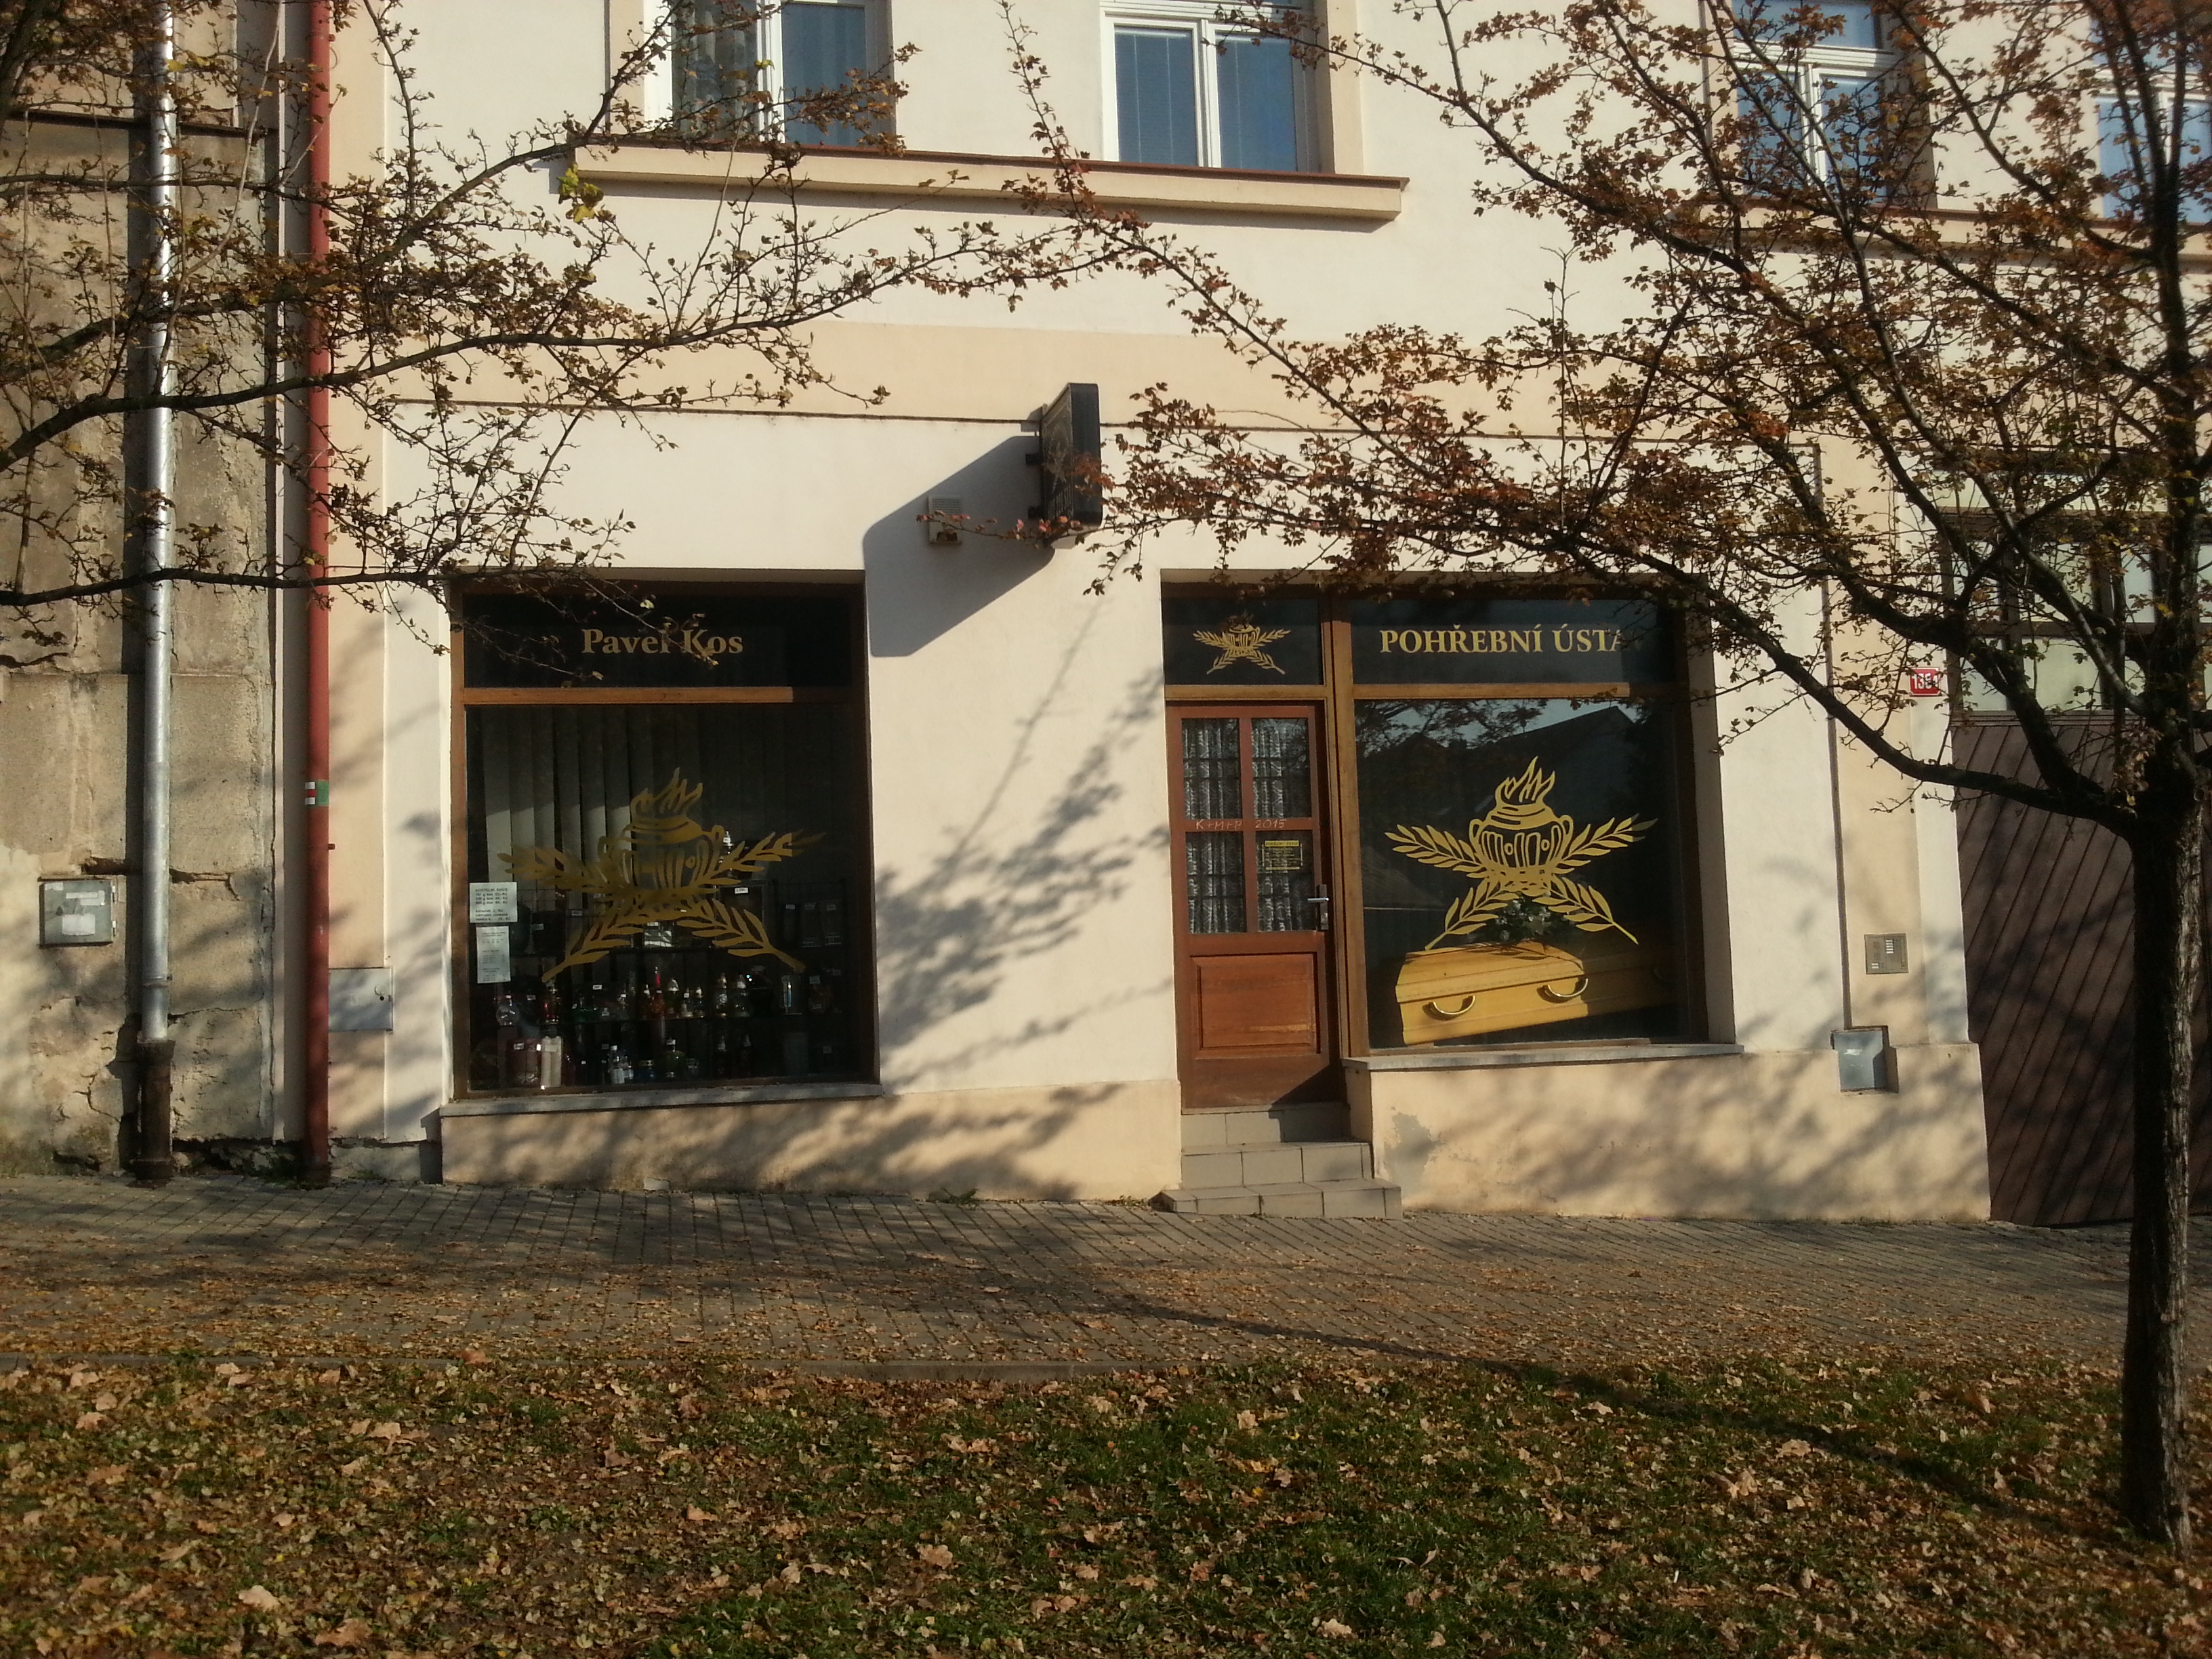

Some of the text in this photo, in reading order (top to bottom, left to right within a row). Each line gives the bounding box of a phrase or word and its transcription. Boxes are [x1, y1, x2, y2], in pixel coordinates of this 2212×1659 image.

[581, 628, 744, 654] Pavel Kos
[1380, 623, 1542, 653] POHŘEBNÍ
[1254, 819, 1288, 829] 2015
